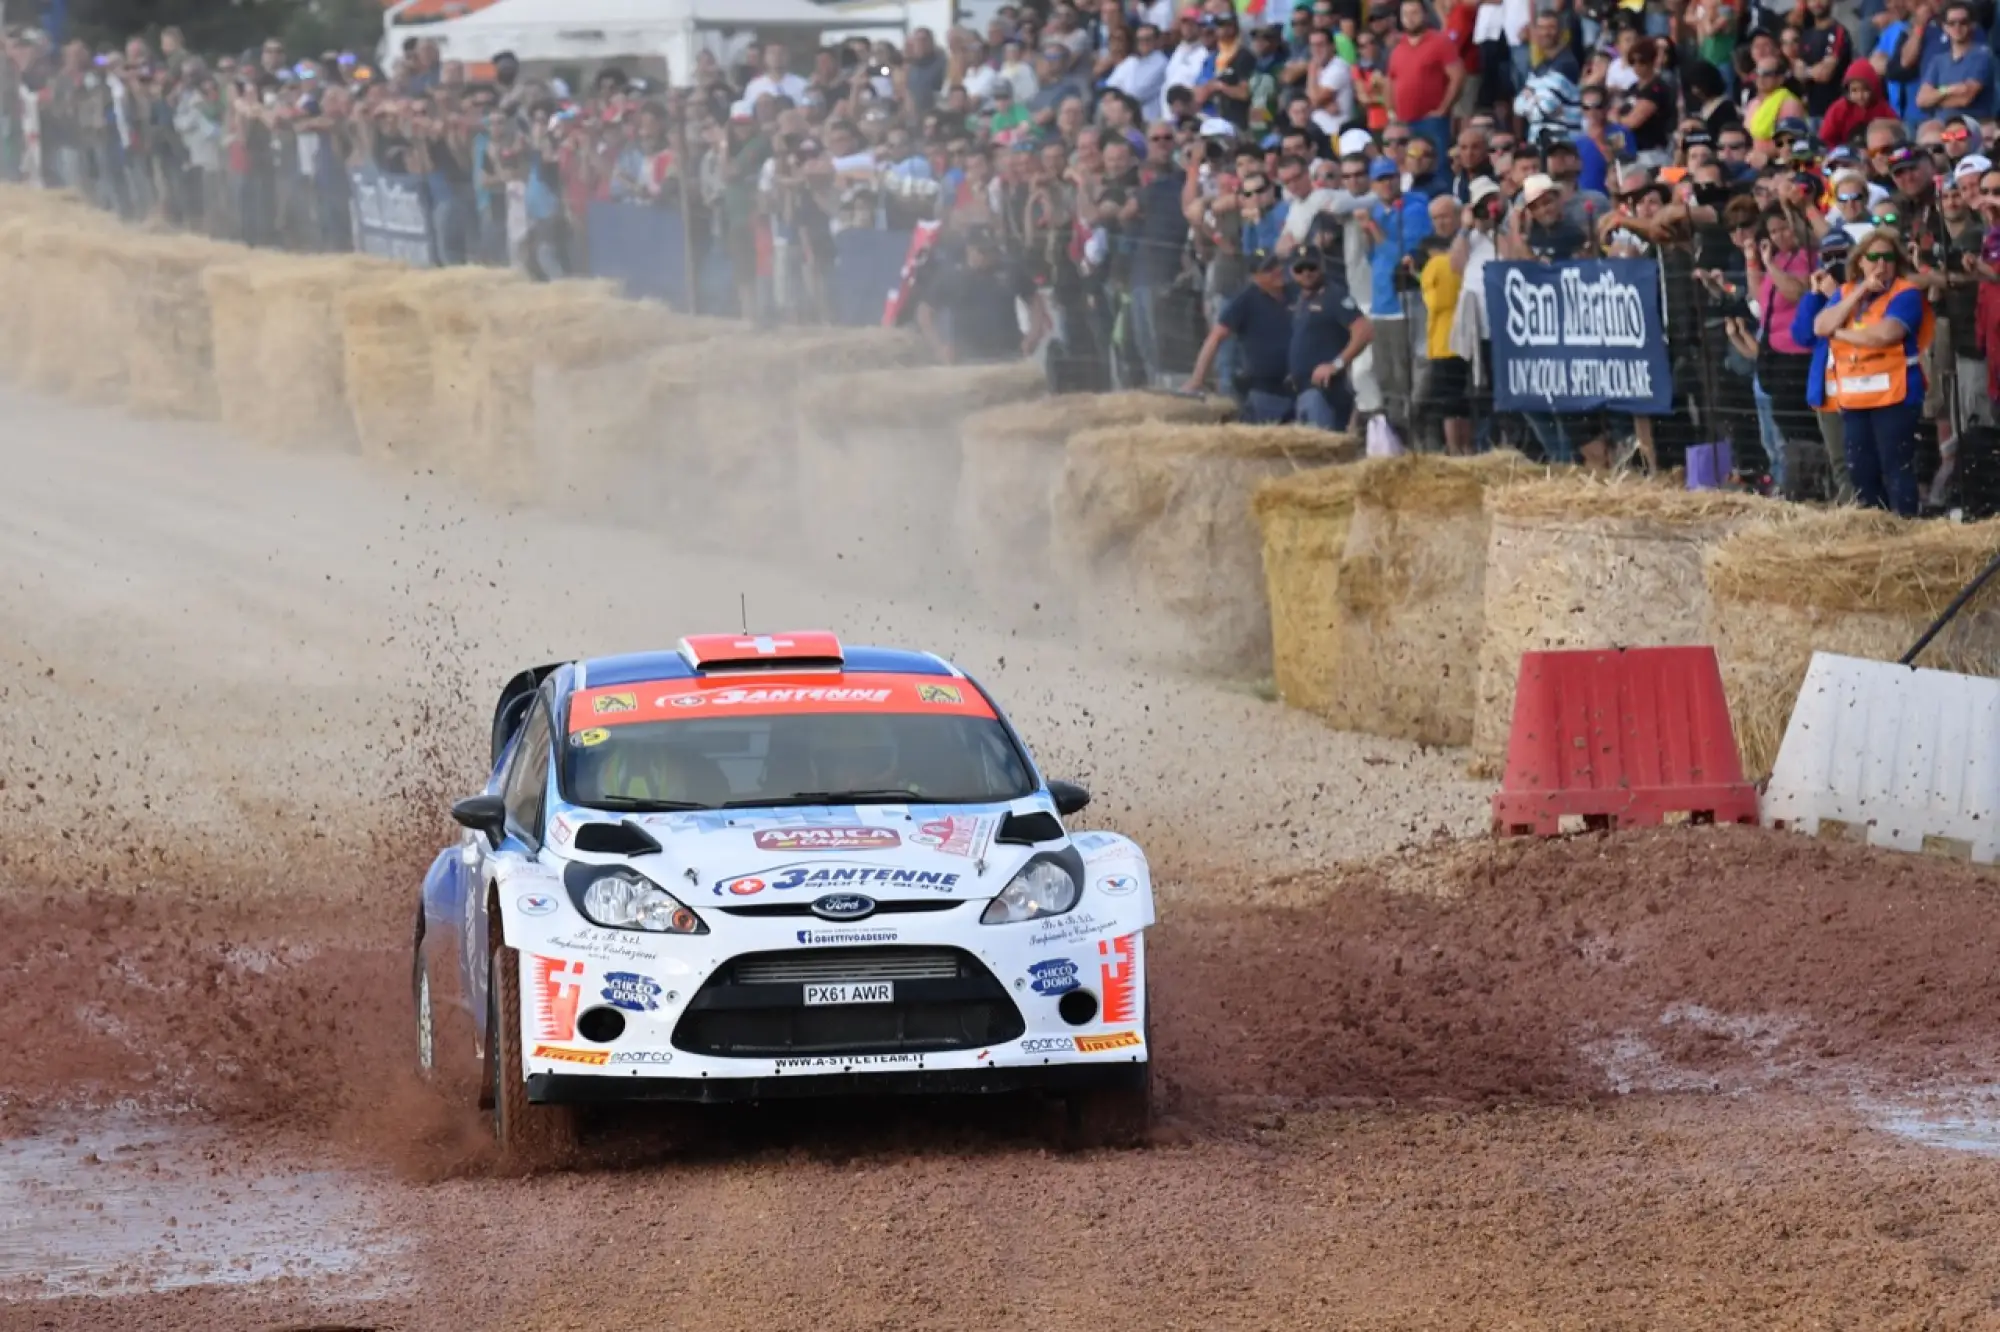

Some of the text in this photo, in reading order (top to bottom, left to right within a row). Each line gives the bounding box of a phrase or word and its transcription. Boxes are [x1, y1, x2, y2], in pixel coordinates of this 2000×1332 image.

[1505, 266, 1645, 348] San Martino
[1571, 358, 1653, 397] SPETTACOLARE
[761, 829, 895, 842] AMICA
[825, 899, 860, 910] Ford
[815, 933, 898, 944] OBIETTIVOADESIVO
[808, 984, 890, 1002] PX61 AWR
[611, 1051, 673, 1063] sparco
